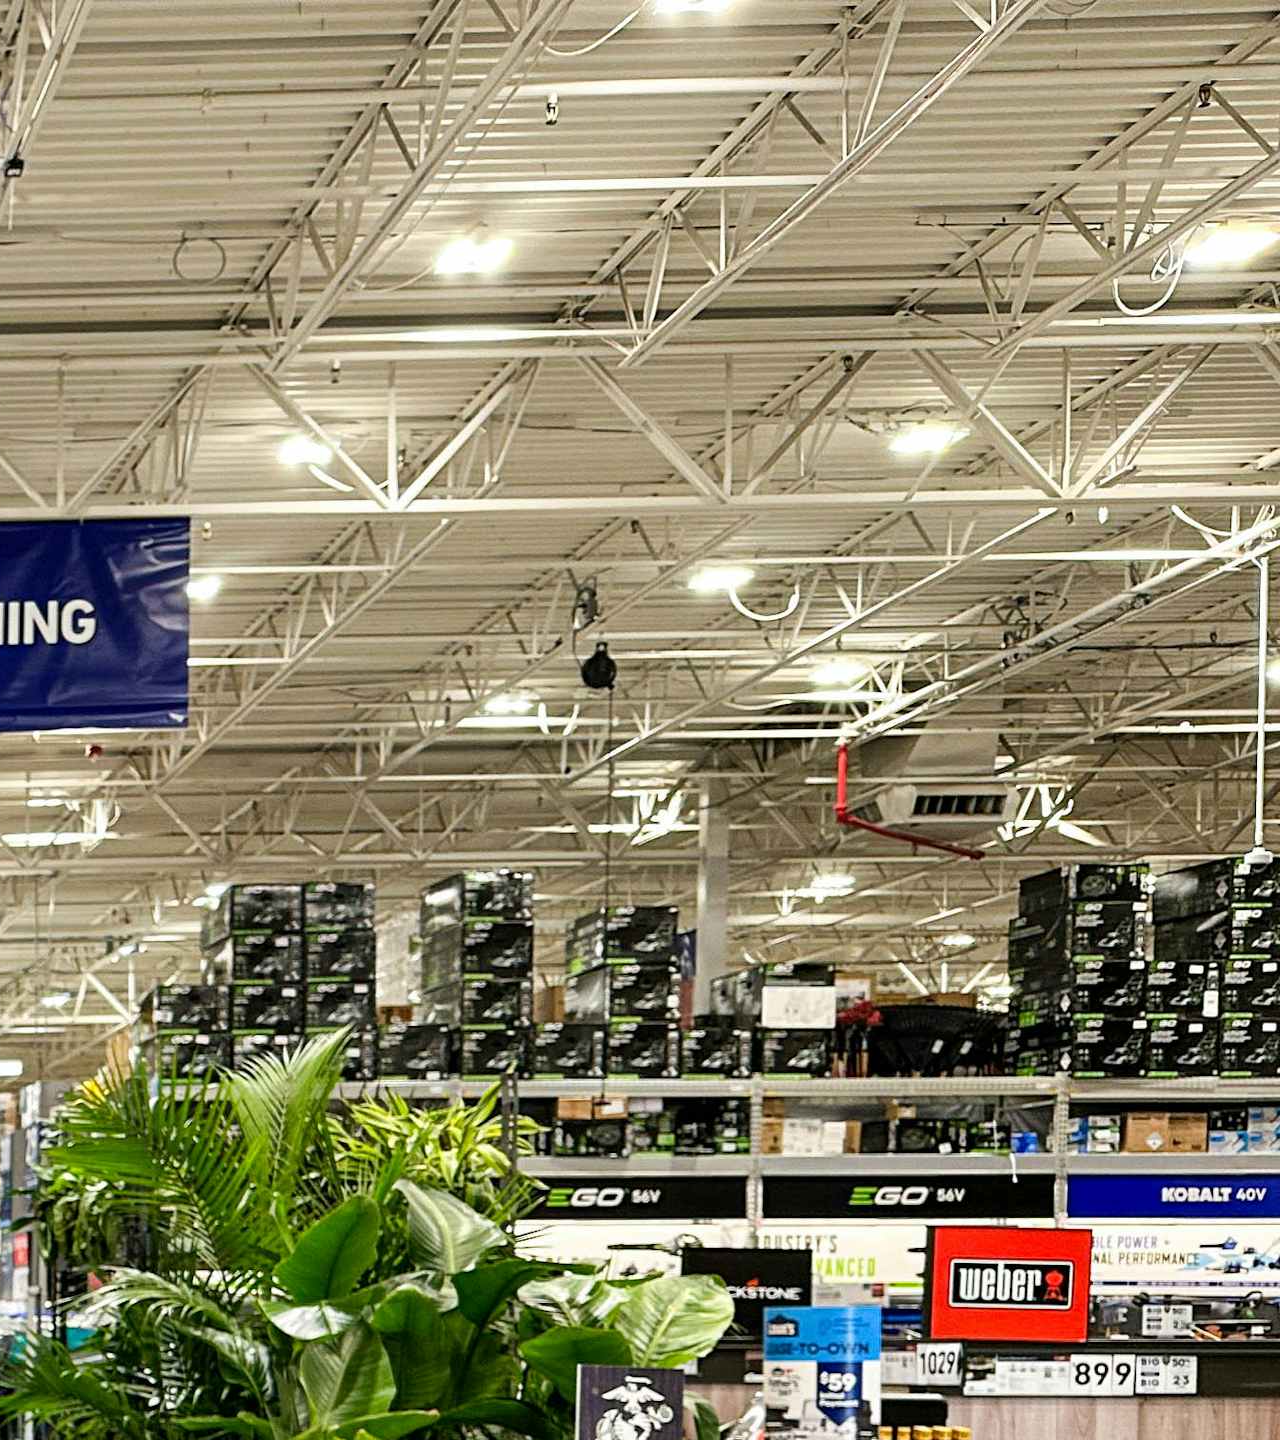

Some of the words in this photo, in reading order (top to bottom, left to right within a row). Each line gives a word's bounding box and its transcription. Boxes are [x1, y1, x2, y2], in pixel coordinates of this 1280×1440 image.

[546, 1188, 625, 1207] EGO
[849, 1185, 931, 1206] EGO
[1161, 1187, 1231, 1202] KOBALT
[1236, 1188, 1267, 1201] 40V
[959, 1266, 1042, 1300] weber
[920, 1352, 955, 1375] 1029
